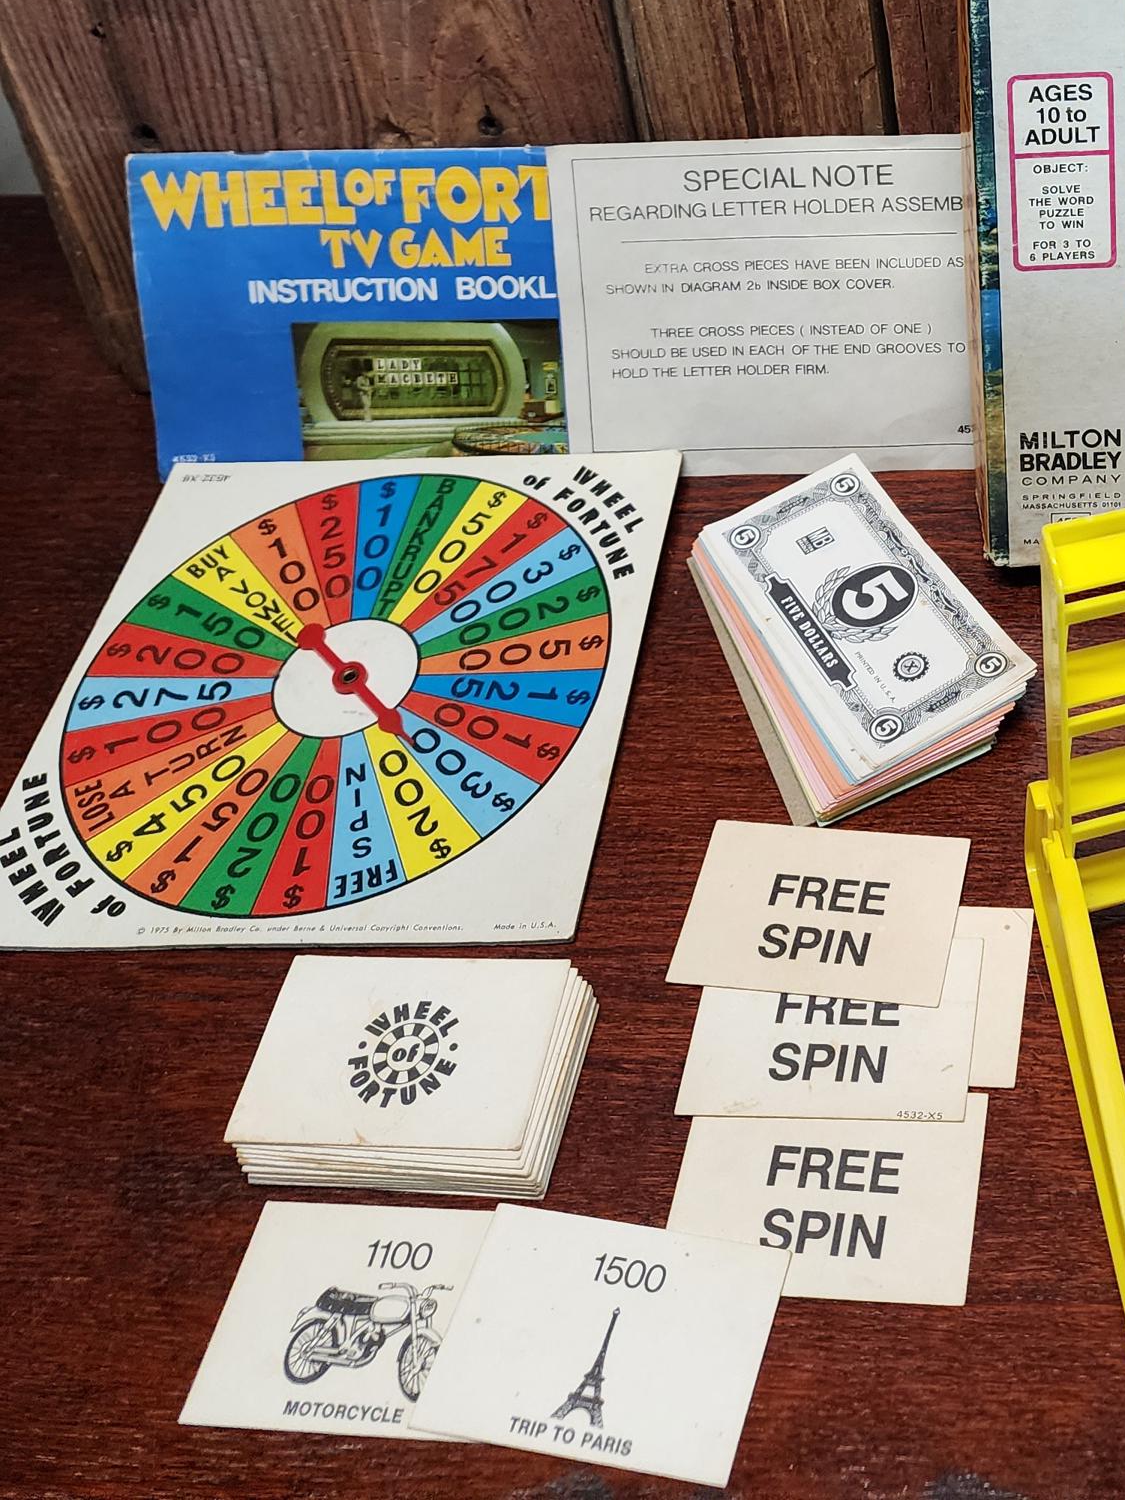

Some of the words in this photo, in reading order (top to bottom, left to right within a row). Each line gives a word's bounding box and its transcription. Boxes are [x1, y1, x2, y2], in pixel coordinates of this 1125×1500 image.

[1029, 84, 1093, 103] AGES
[1036, 107, 1061, 124] 10
[1066, 108, 1087, 123] to
[1025, 126, 1100, 146] ADULT
[683, 167, 806, 192] SPECIAL
[812, 164, 894, 188] NOTE
[1033, 163, 1088, 174] OBJECT:
[140, 170, 356, 231] WHEEL
[344, 169, 395, 207] OF
[400, 165, 551, 224] FORT
[1029, 199, 1051, 207] THE
[1058, 196, 1094, 206] WORD
[1042, 185, 1081, 195] SOLVE
[589, 202, 707, 222] REGARDING
[712, 199, 787, 217] LETTER
[794, 198, 874, 214] HOLDER
[881, 196, 963, 212] ASSEMB
[1039, 209, 1084, 218] PUZZLE
[1040, 221, 1055, 230] TO
[1062, 220, 1084, 229] WIN
[320, 229, 383, 268] TV
[389, 228, 511, 268] GAME
[1029, 253, 1036, 262] 6
[1042, 251, 1095, 261] PLAYERS
[1033, 241, 1056, 250] FOR
[1063, 240, 1069, 249] 3
[1075, 239, 1091, 248] TO
[645, 263, 688, 274] EXTRA
[693, 261, 739, 273] CROSS
[745, 259, 789, 271] PIECES
[795, 259, 830, 270] HAVE
[835, 258, 870, 269] BEEN
[876, 257, 942, 269] INCLUDED
[947, 256, 964, 267] AS
[248, 277, 438, 305] INSTRUCTION
[456, 275, 557, 300] BOOKL
[606, 284, 657, 295] SHOWN
[662, 283, 674, 293] IN
[681, 281, 741, 293] DIAGRAM
[746, 281, 761, 291] 2b
[767, 279, 808, 290] INSIDE
[814, 279, 840, 290] BOX
[846, 278, 895, 289] COVER.
[650, 327, 695, 338] THREE
[699, 326, 745, 337] CROSS
[750, 325, 795, 336] PIECES
[870, 324, 888, 334] OF
[893, 323, 922, 334] ONE
[611, 348, 666, 359] SHOULD
[671, 348, 688, 358] BE
[692, 347, 727, 357] USED
[732, 346, 744, 357] IN
[749, 345, 785, 356] EACH
[791, 345, 810, 356] OF
[814, 344, 839, 355] THE
[844, 344, 871, 354] END
[876, 342, 942, 354] GROOVES
[948, 342, 966, 353] TO
[612, 368, 648, 379] HOLD
[652, 367, 678, 377] THE
[683, 366, 732, 377] LETTER
[737, 364, 790, 375] HOLDER
[795, 364, 829, 375] FIRM.
[1020, 429, 1121, 450] MILTON
[1020, 451, 1122, 472] BRADLEY
[835, 477, 856, 493] 5
[1021, 474, 1121, 486] COMPANY
[1022, 492, 1121, 501] SPRINGFIELD
[572, 465, 645, 534] WHEEL
[1022, 502, 1097, 511] MASSACHUSETTS
[356, 481, 397, 591] $100
[413, 491, 507, 594] $500
[523, 474, 552, 491] of
[552, 487, 635, 580] FORTUNE
[737, 528, 755, 546] 5
[186, 543, 229, 580] BUY
[379, 478, 457, 616] BANKRUPT
[217, 566, 236, 582] A
[257, 518, 320, 611] $100
[450, 544, 581, 623] $300
[842, 570, 909, 621] 5
[147, 592, 265, 650] $150
[229, 579, 297, 643] VOWEL
[459, 586, 601, 645] $200
[780, 595, 806, 622] FIVE
[799, 621, 839, 669] DOLLARS
[459, 634, 604, 670] $500
[79, 680, 232, 711] $275
[451, 677, 590, 706] $125
[877, 719, 897, 737] 5
[144, 725, 247, 786] TURN
[74, 779, 114, 832] LOSE
[109, 779, 135, 799] A
[379, 750, 451, 859] $200
[105, 755, 245, 863] $450
[345, 763, 371, 858] SPIN
[22, 772, 95, 898] FORTUNE
[151, 768, 269, 894] $150
[211, 773, 300, 910] $200
[0, 827, 65, 927] WHEEL
[334, 859, 397, 898] FREE
[90, 895, 127, 917] of
[767, 873, 891, 916] FREE
[757, 923, 872, 968] SPIN
[365, 1001, 459, 1038] WHEEL
[775, 993, 900, 1027] FREE
[392, 1043, 420, 1062] of
[768, 1042, 888, 1085] SPIN
[348, 1055, 457, 1108] FORTUNE
[897, 1110, 943, 1120] 4532-X5
[765, 1144, 904, 1195] FREE
[758, 1207, 887, 1260] SPIN
[365, 1239, 433, 1272] 1100
[592, 1252, 668, 1294] 1500
[282, 1399, 405, 1425] MOTORCYCLE
[508, 1415, 546, 1439] TRIP
[546, 1422, 576, 1445] TO
[581, 1431, 634, 1457] PARIS
